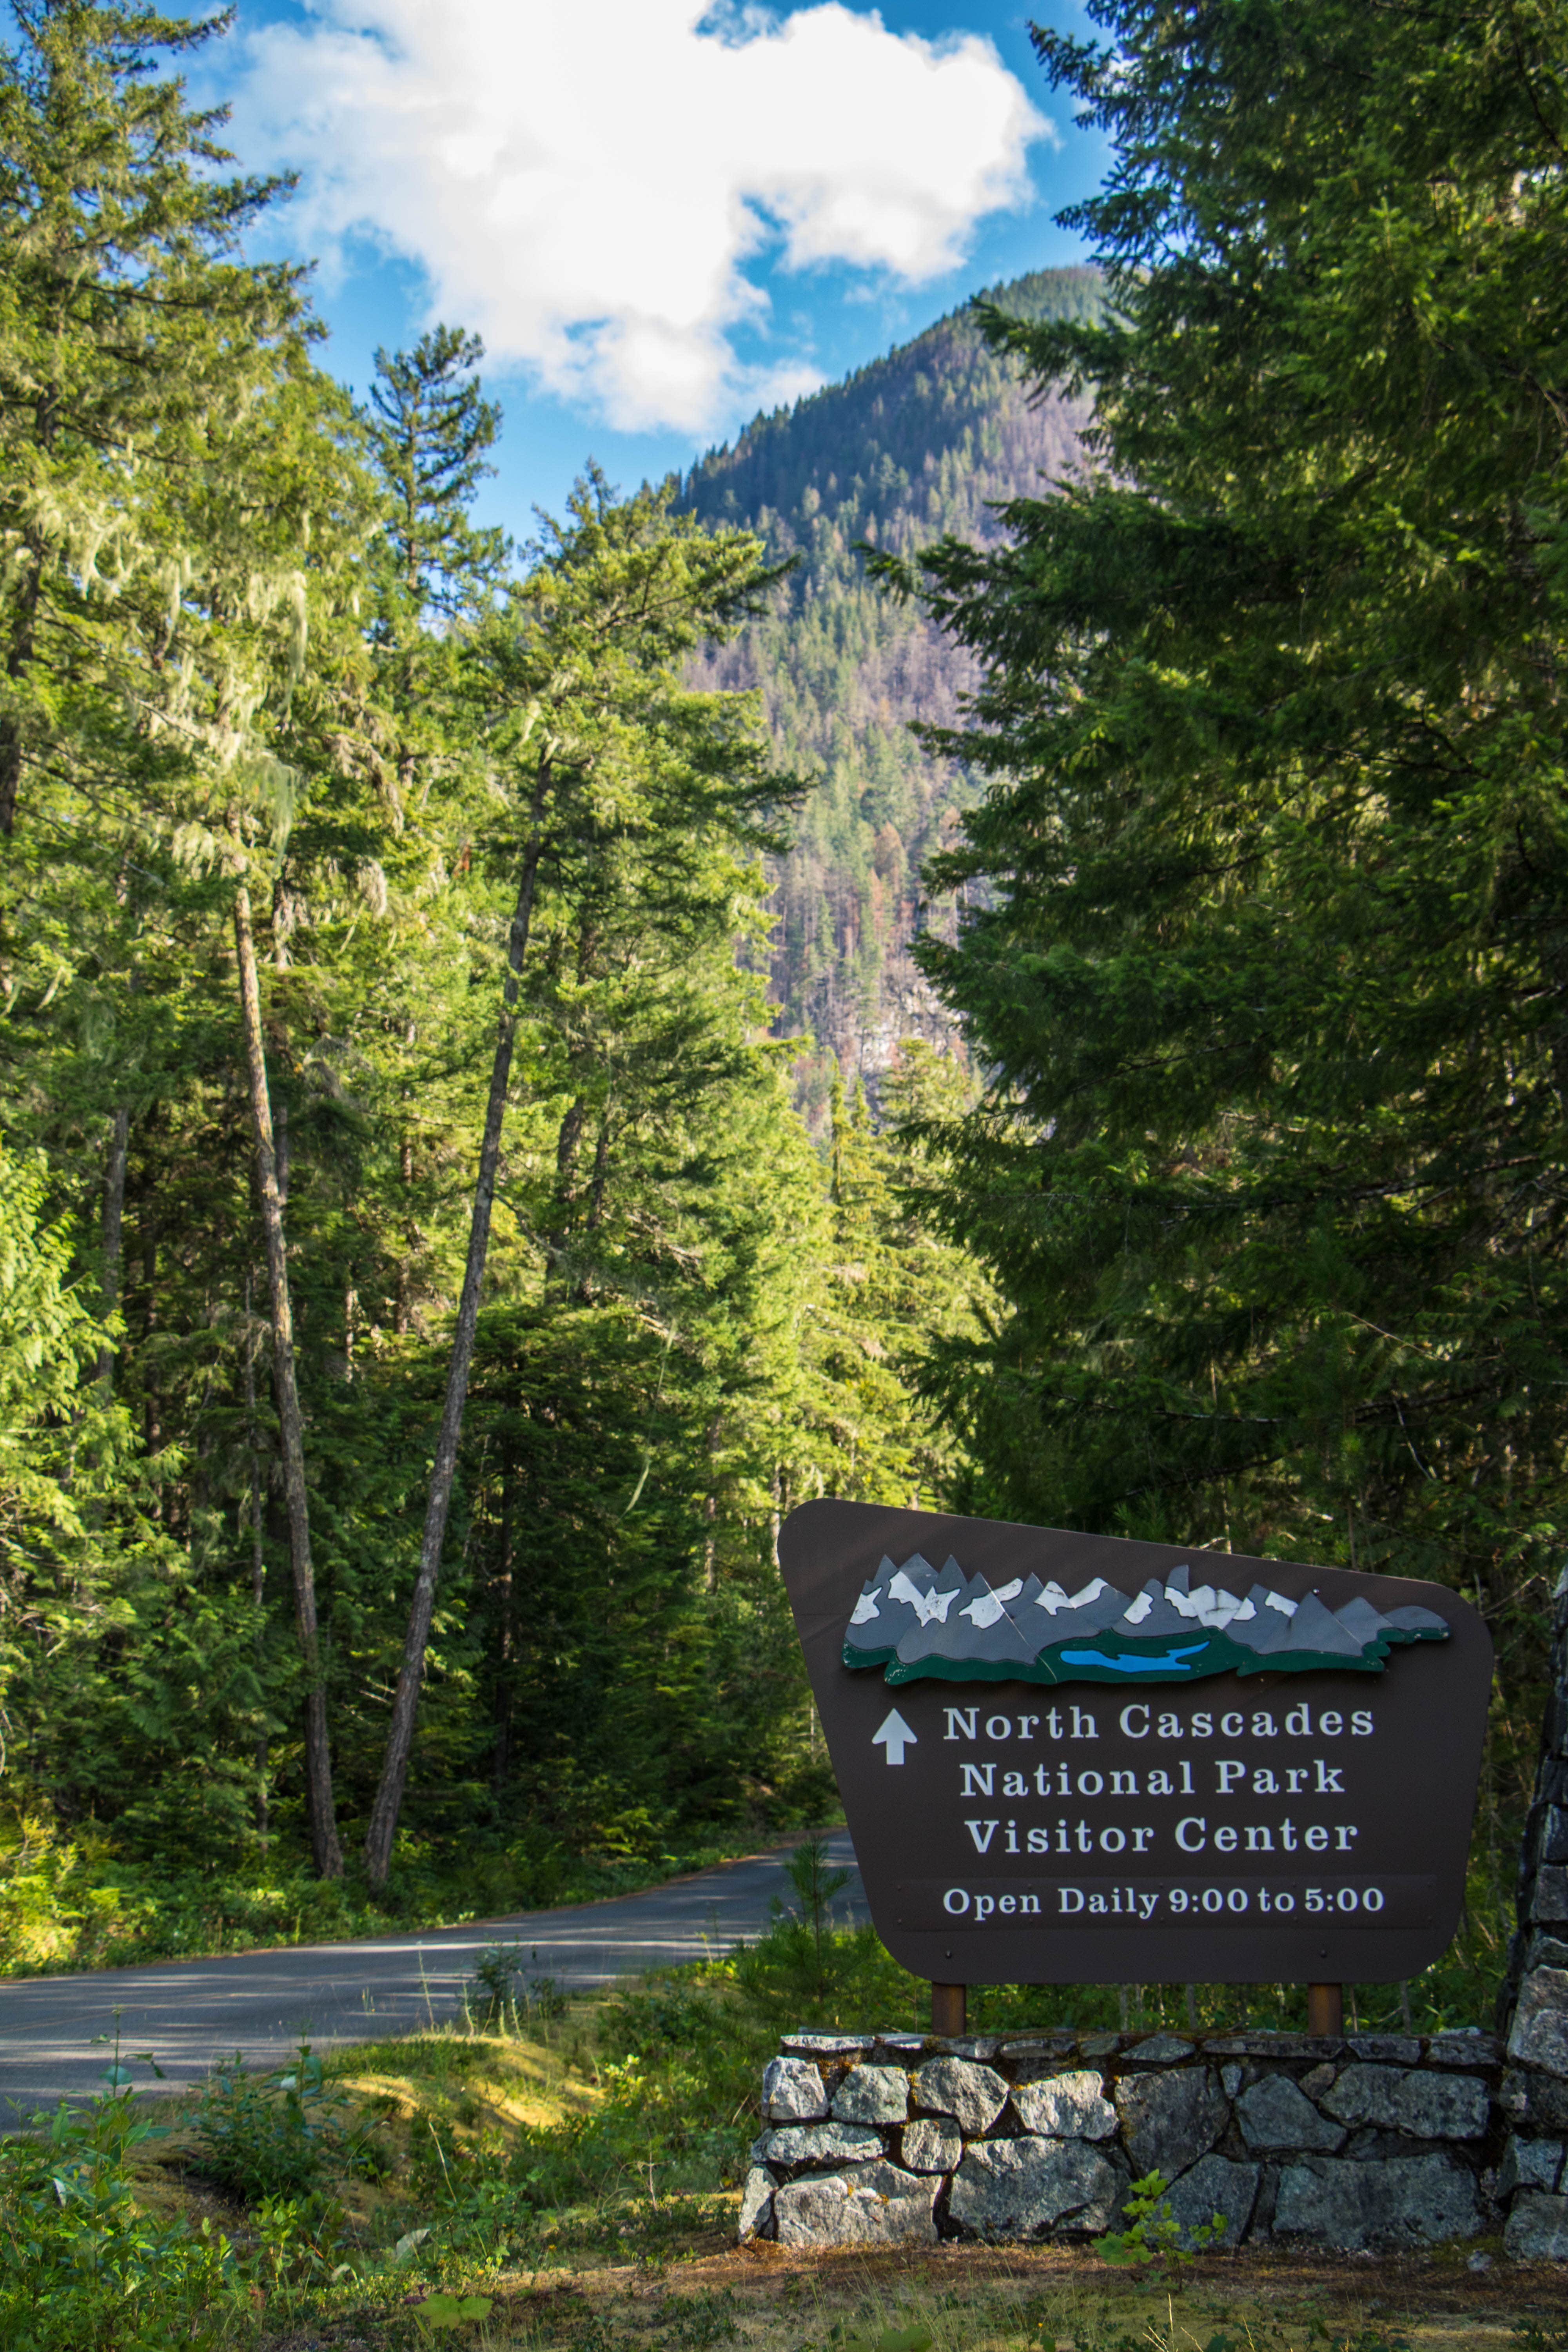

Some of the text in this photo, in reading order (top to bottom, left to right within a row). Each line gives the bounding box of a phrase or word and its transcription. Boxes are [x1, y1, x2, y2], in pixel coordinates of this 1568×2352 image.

[943, 1703, 1373, 1740] North Cascades
[960, 1760, 1345, 1796] National Park
[964, 1818, 1357, 1853] Visitor Center
[943, 1887, 1383, 1920] Open Daily 9:00 to 5:00
